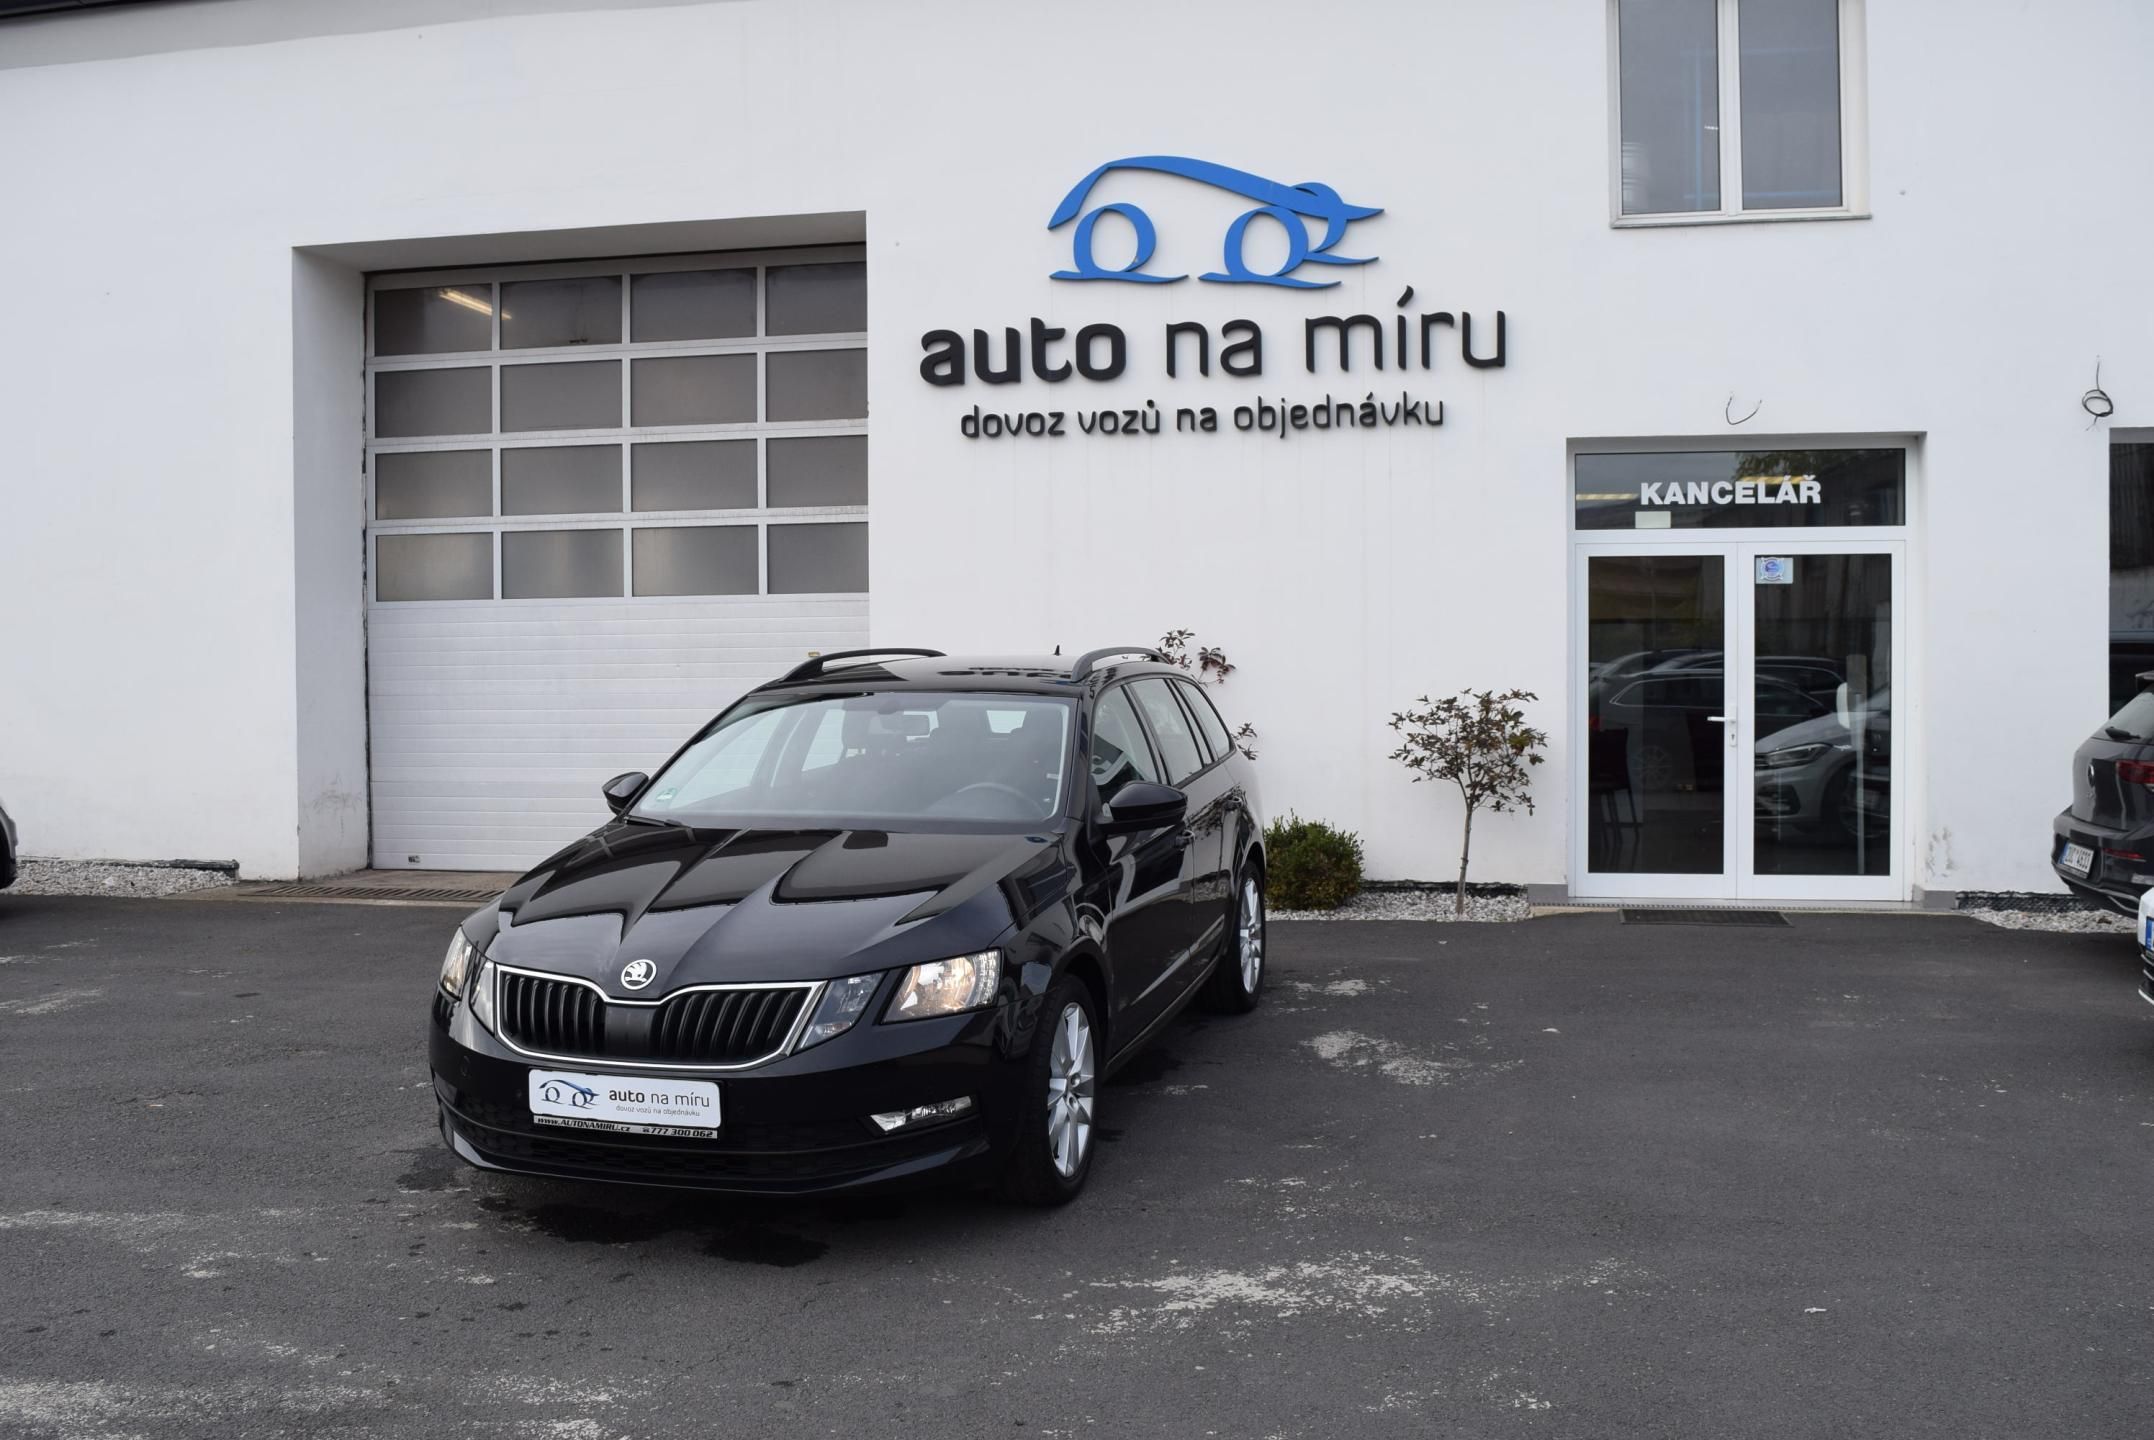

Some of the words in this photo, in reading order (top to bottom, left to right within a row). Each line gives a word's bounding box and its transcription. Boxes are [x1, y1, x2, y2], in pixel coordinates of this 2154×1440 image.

[919, 317, 1127, 388] auto
[1165, 318, 1263, 379] na
[1305, 285, 1507, 374] míru
[960, 404, 1066, 440] dovoz
[1077, 399, 1161, 436] vozů
[1176, 407, 1218, 434] na
[1233, 391, 1444, 440] objednávku
[1640, 474, 1822, 505] KANCELÁŘ
[608, 1089, 646, 1104] auto
[651, 1092, 669, 1105] na
[675, 1091, 710, 1108] míru
[615, 1105, 635, 1113] dovoz
[663, 1108, 701, 1117] objednávku
[536, 1117, 632, 1133] www.AUTONAMIRU.cz
[670, 1129, 691, 1137] 300
[692, 1130, 714, 1138] 062
